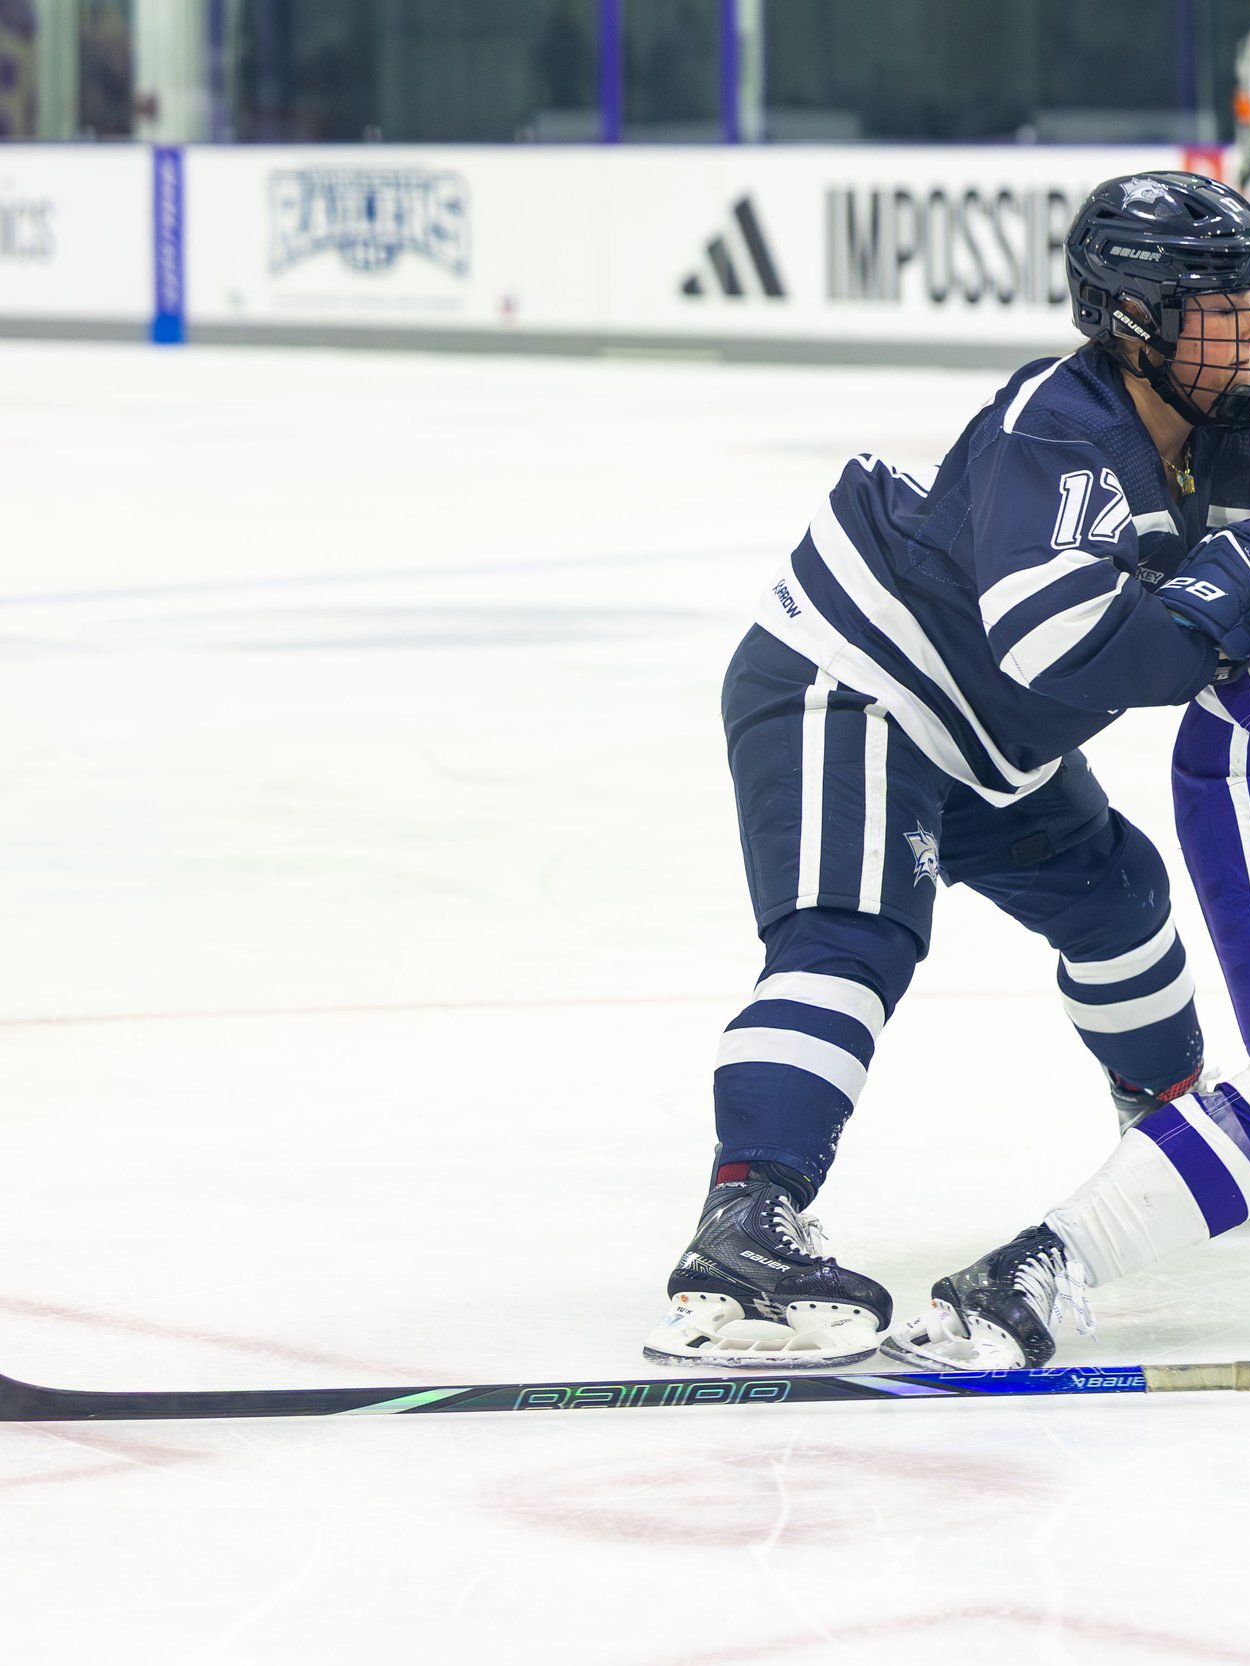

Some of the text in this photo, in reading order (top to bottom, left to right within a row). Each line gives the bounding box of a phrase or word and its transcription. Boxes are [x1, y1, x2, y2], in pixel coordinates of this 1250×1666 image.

[824, 186, 1069, 304] IMPOSSIB
[1110, 245, 1162, 263] BAUER
[1112, 309, 1151, 341] BAUER
[1050, 467, 1133, 550] 17
[1137, 567, 1165, 585] KEY
[739, 1249, 792, 1274] BAUER
[1086, 1375, 1147, 1389] BAUE
